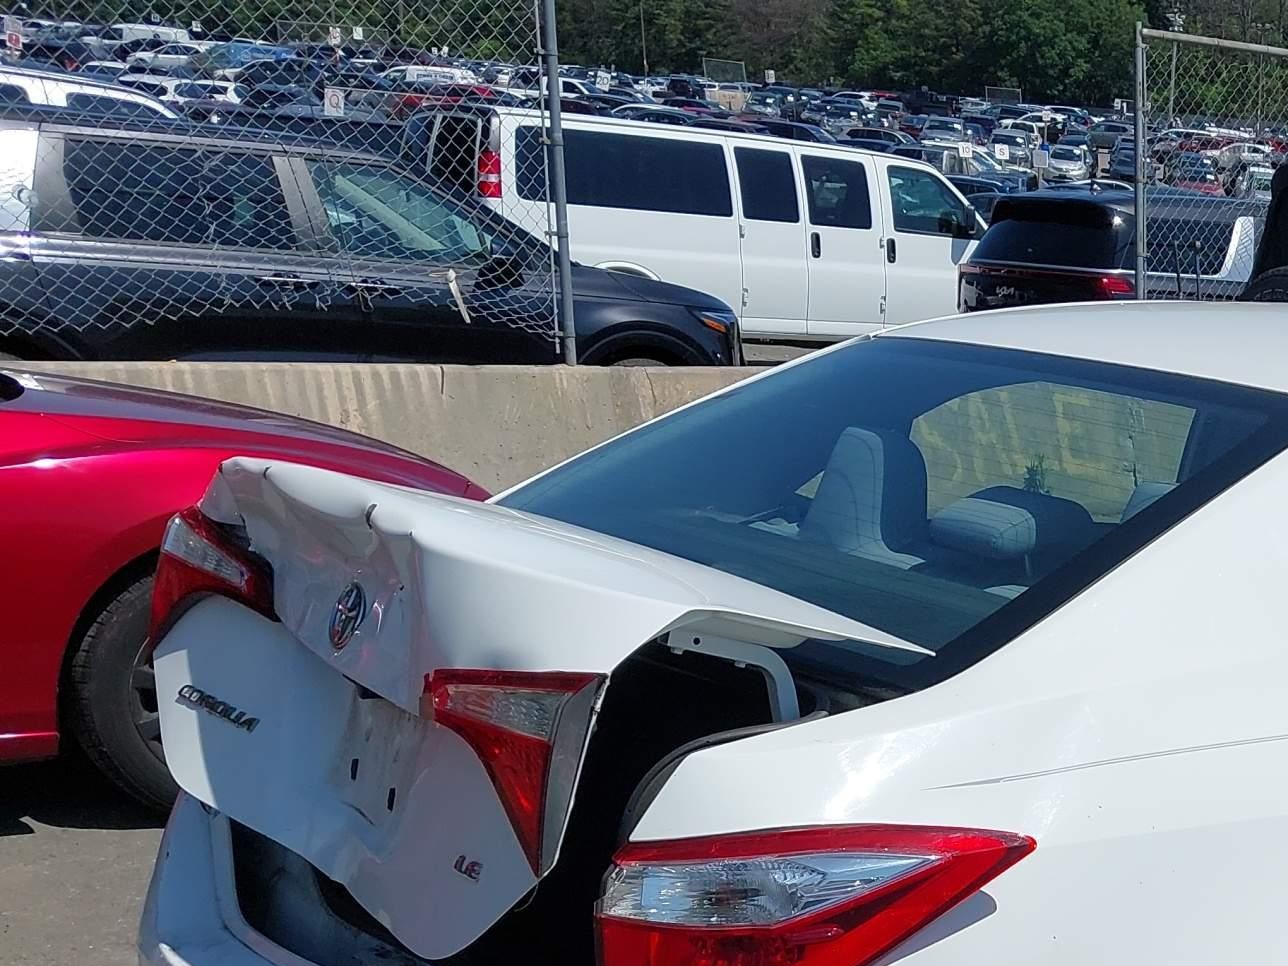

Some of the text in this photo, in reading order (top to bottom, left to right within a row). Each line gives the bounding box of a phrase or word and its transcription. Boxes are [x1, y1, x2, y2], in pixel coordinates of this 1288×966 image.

[330, 93, 341, 113] Q
[176, 684, 261, 734] COROLLA
[454, 855, 483, 880] LE
